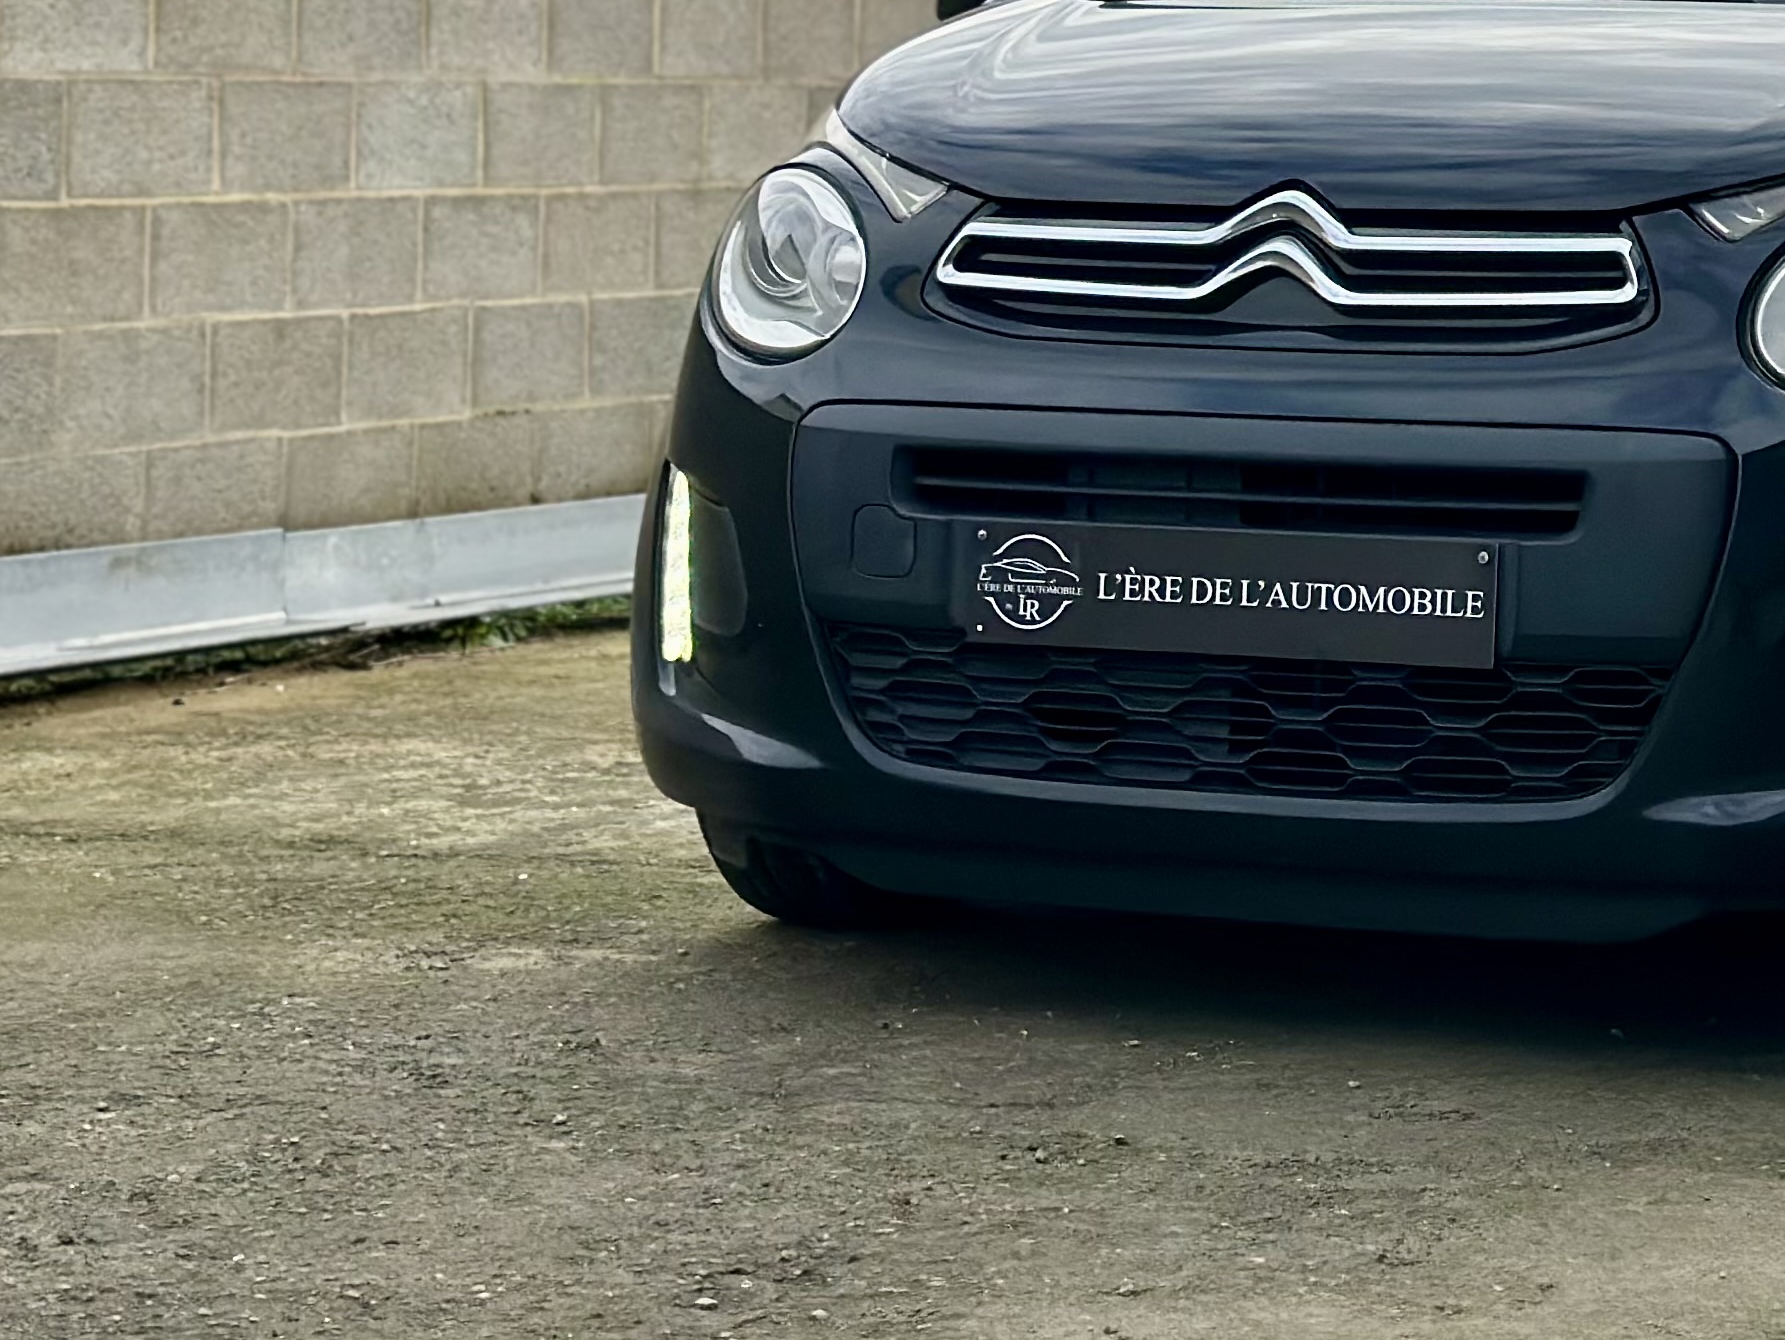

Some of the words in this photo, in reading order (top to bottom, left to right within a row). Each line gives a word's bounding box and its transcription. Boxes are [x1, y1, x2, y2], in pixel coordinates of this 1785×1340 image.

[1096, 566, 1184, 603] L'ÈRE
[1190, 576, 1233, 606] DE
[1239, 579, 1486, 619] L'AUTOMOBILE
